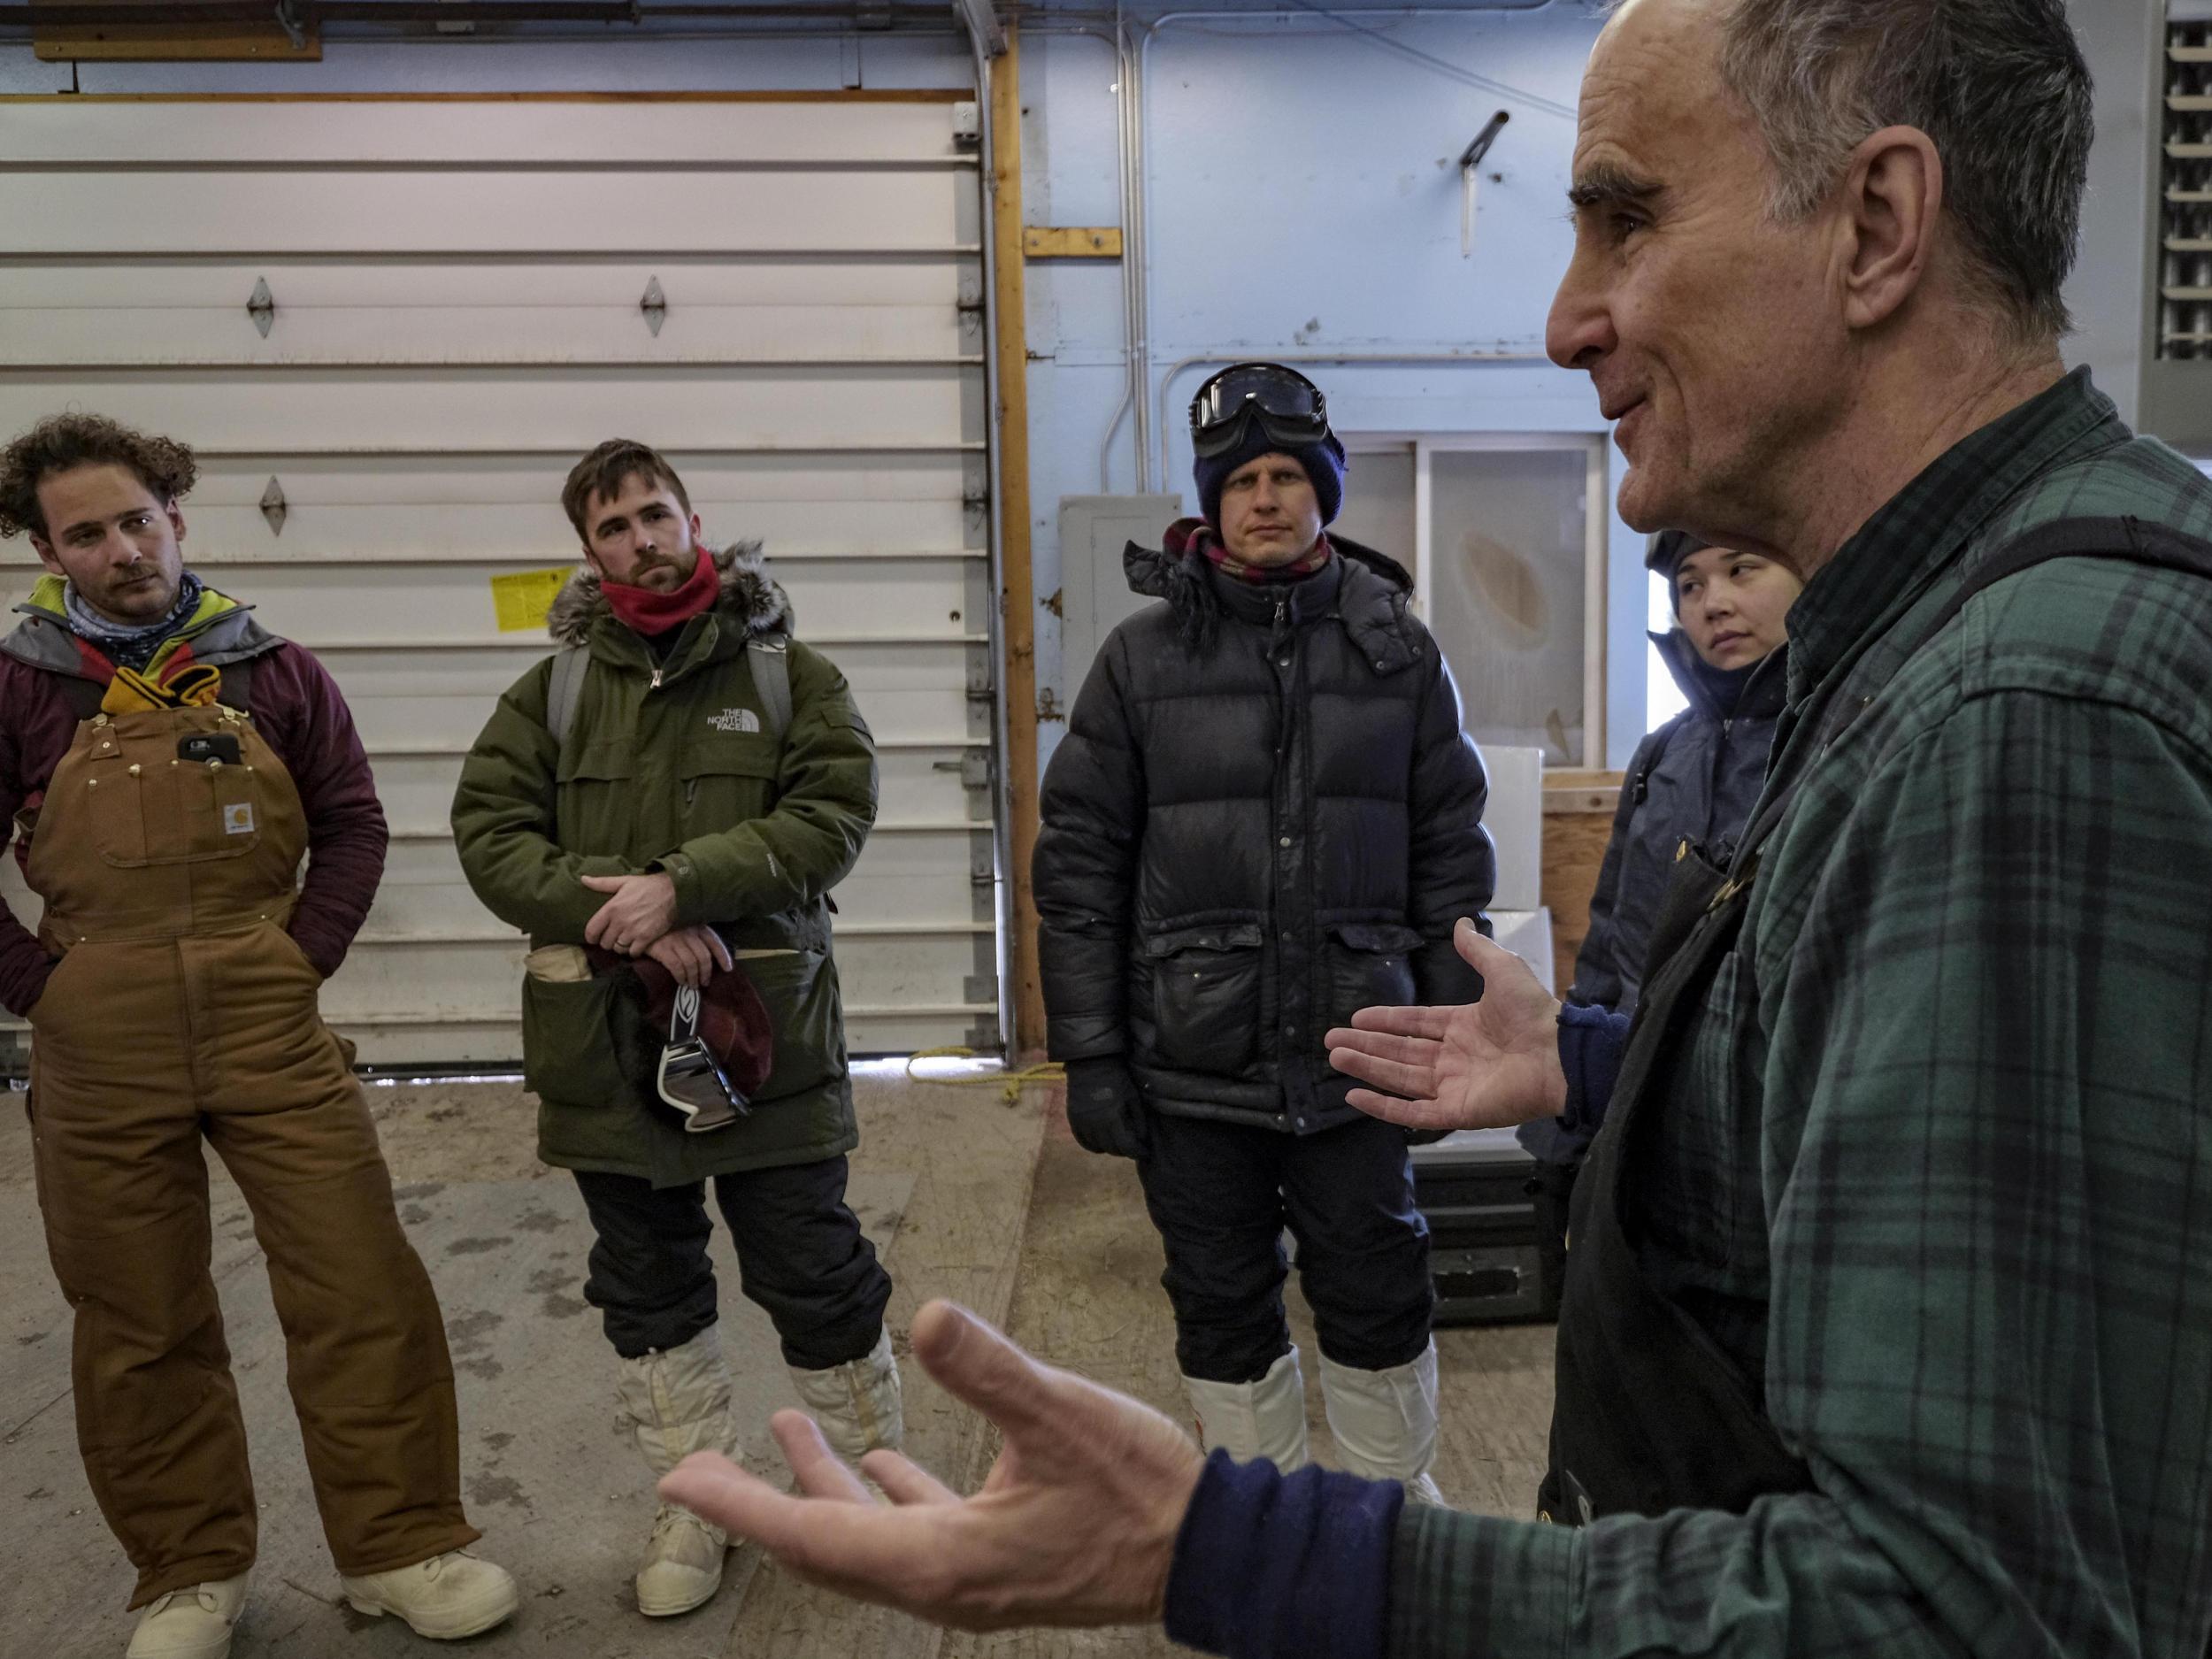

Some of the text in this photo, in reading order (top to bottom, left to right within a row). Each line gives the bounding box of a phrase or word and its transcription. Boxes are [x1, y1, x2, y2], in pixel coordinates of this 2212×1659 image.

[722, 708, 741, 717] THE
[708, 716, 741, 725] NORTH
[717, 723, 741, 732] FACE
